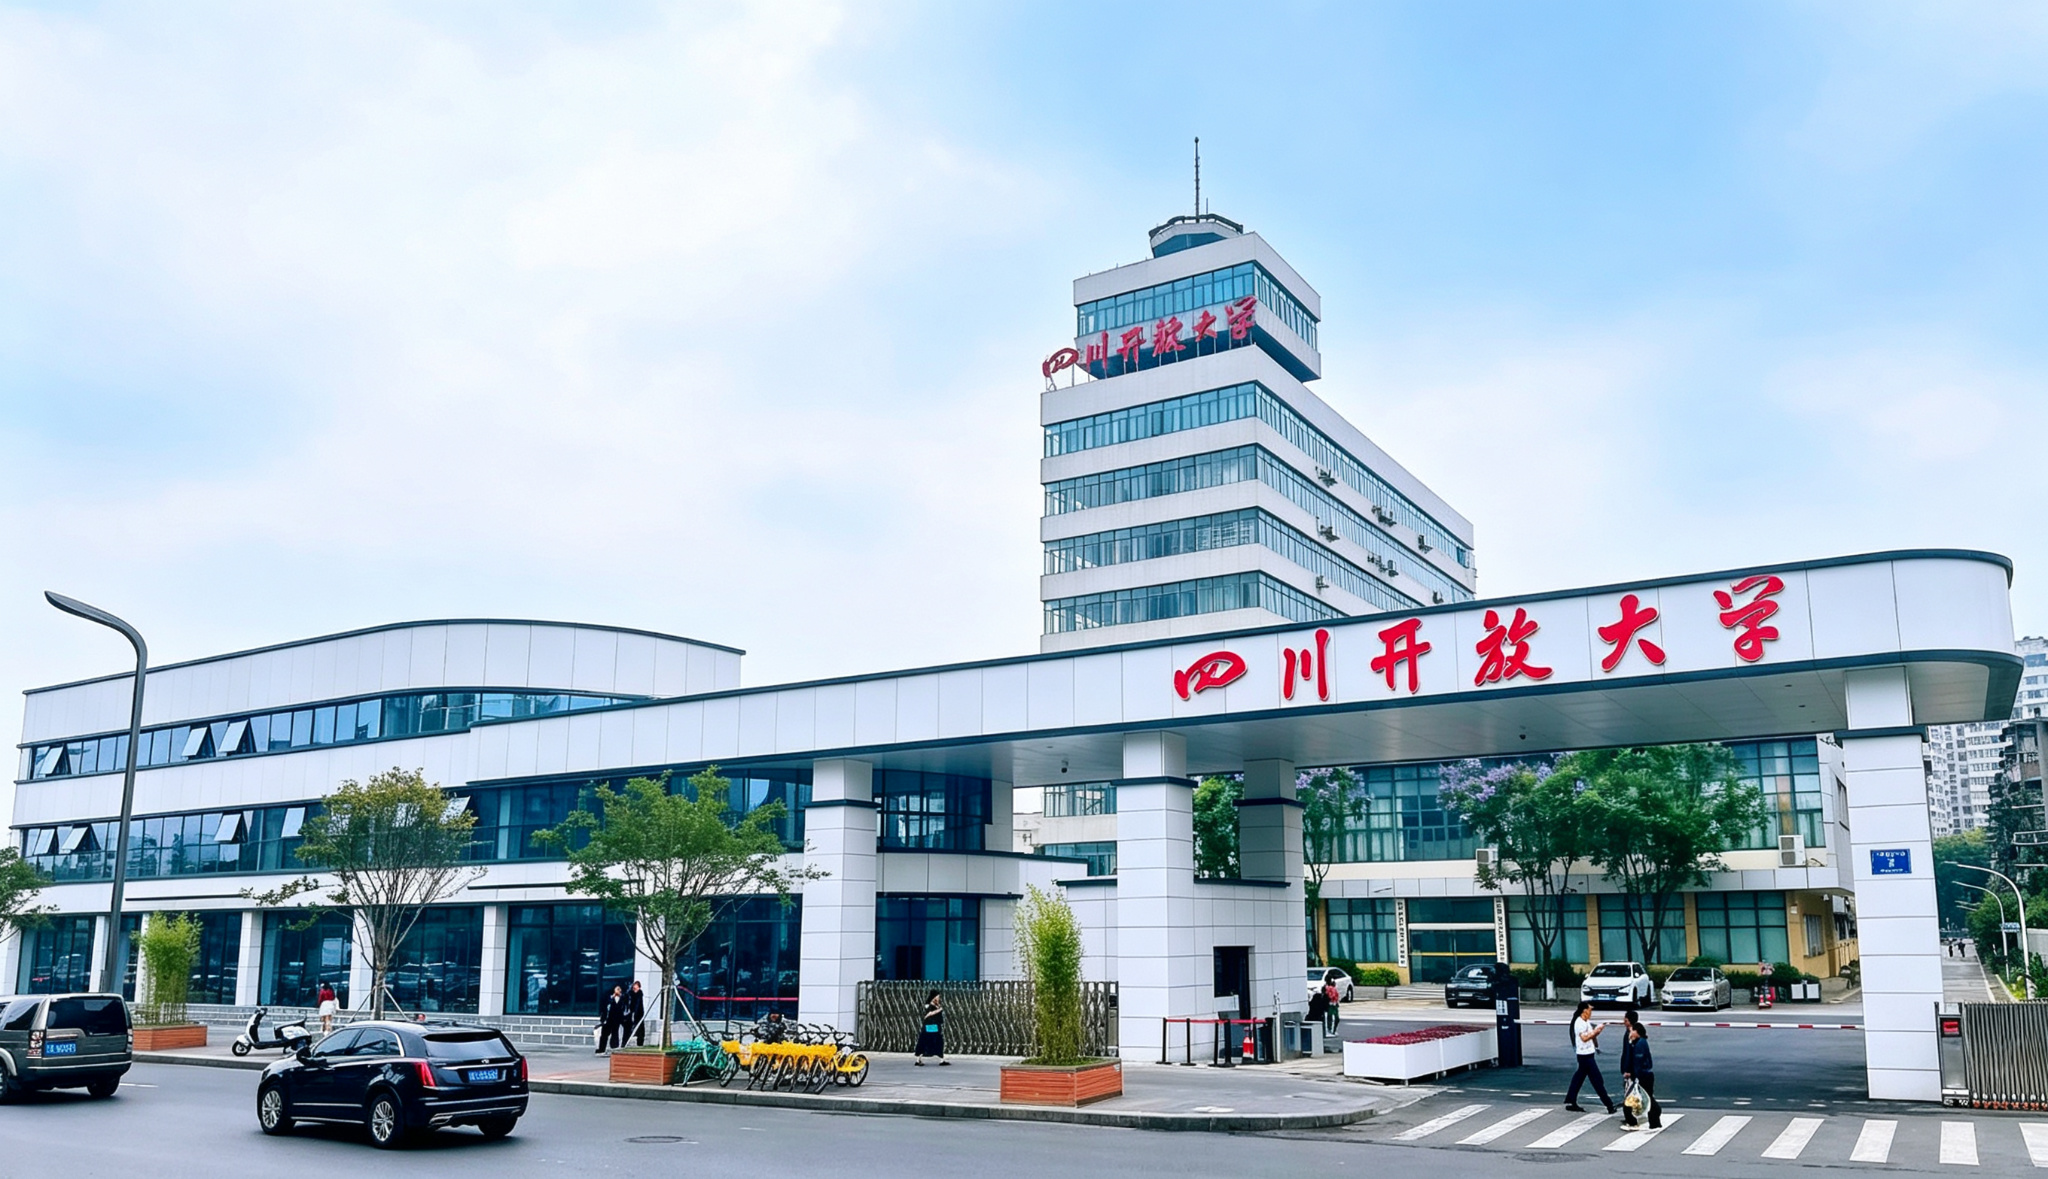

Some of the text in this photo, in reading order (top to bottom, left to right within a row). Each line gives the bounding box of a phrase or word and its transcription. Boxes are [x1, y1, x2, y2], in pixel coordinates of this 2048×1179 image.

[1042, 296, 1256, 377] 四川开放大学
[1174, 575, 1784, 701] 四川开放大学
